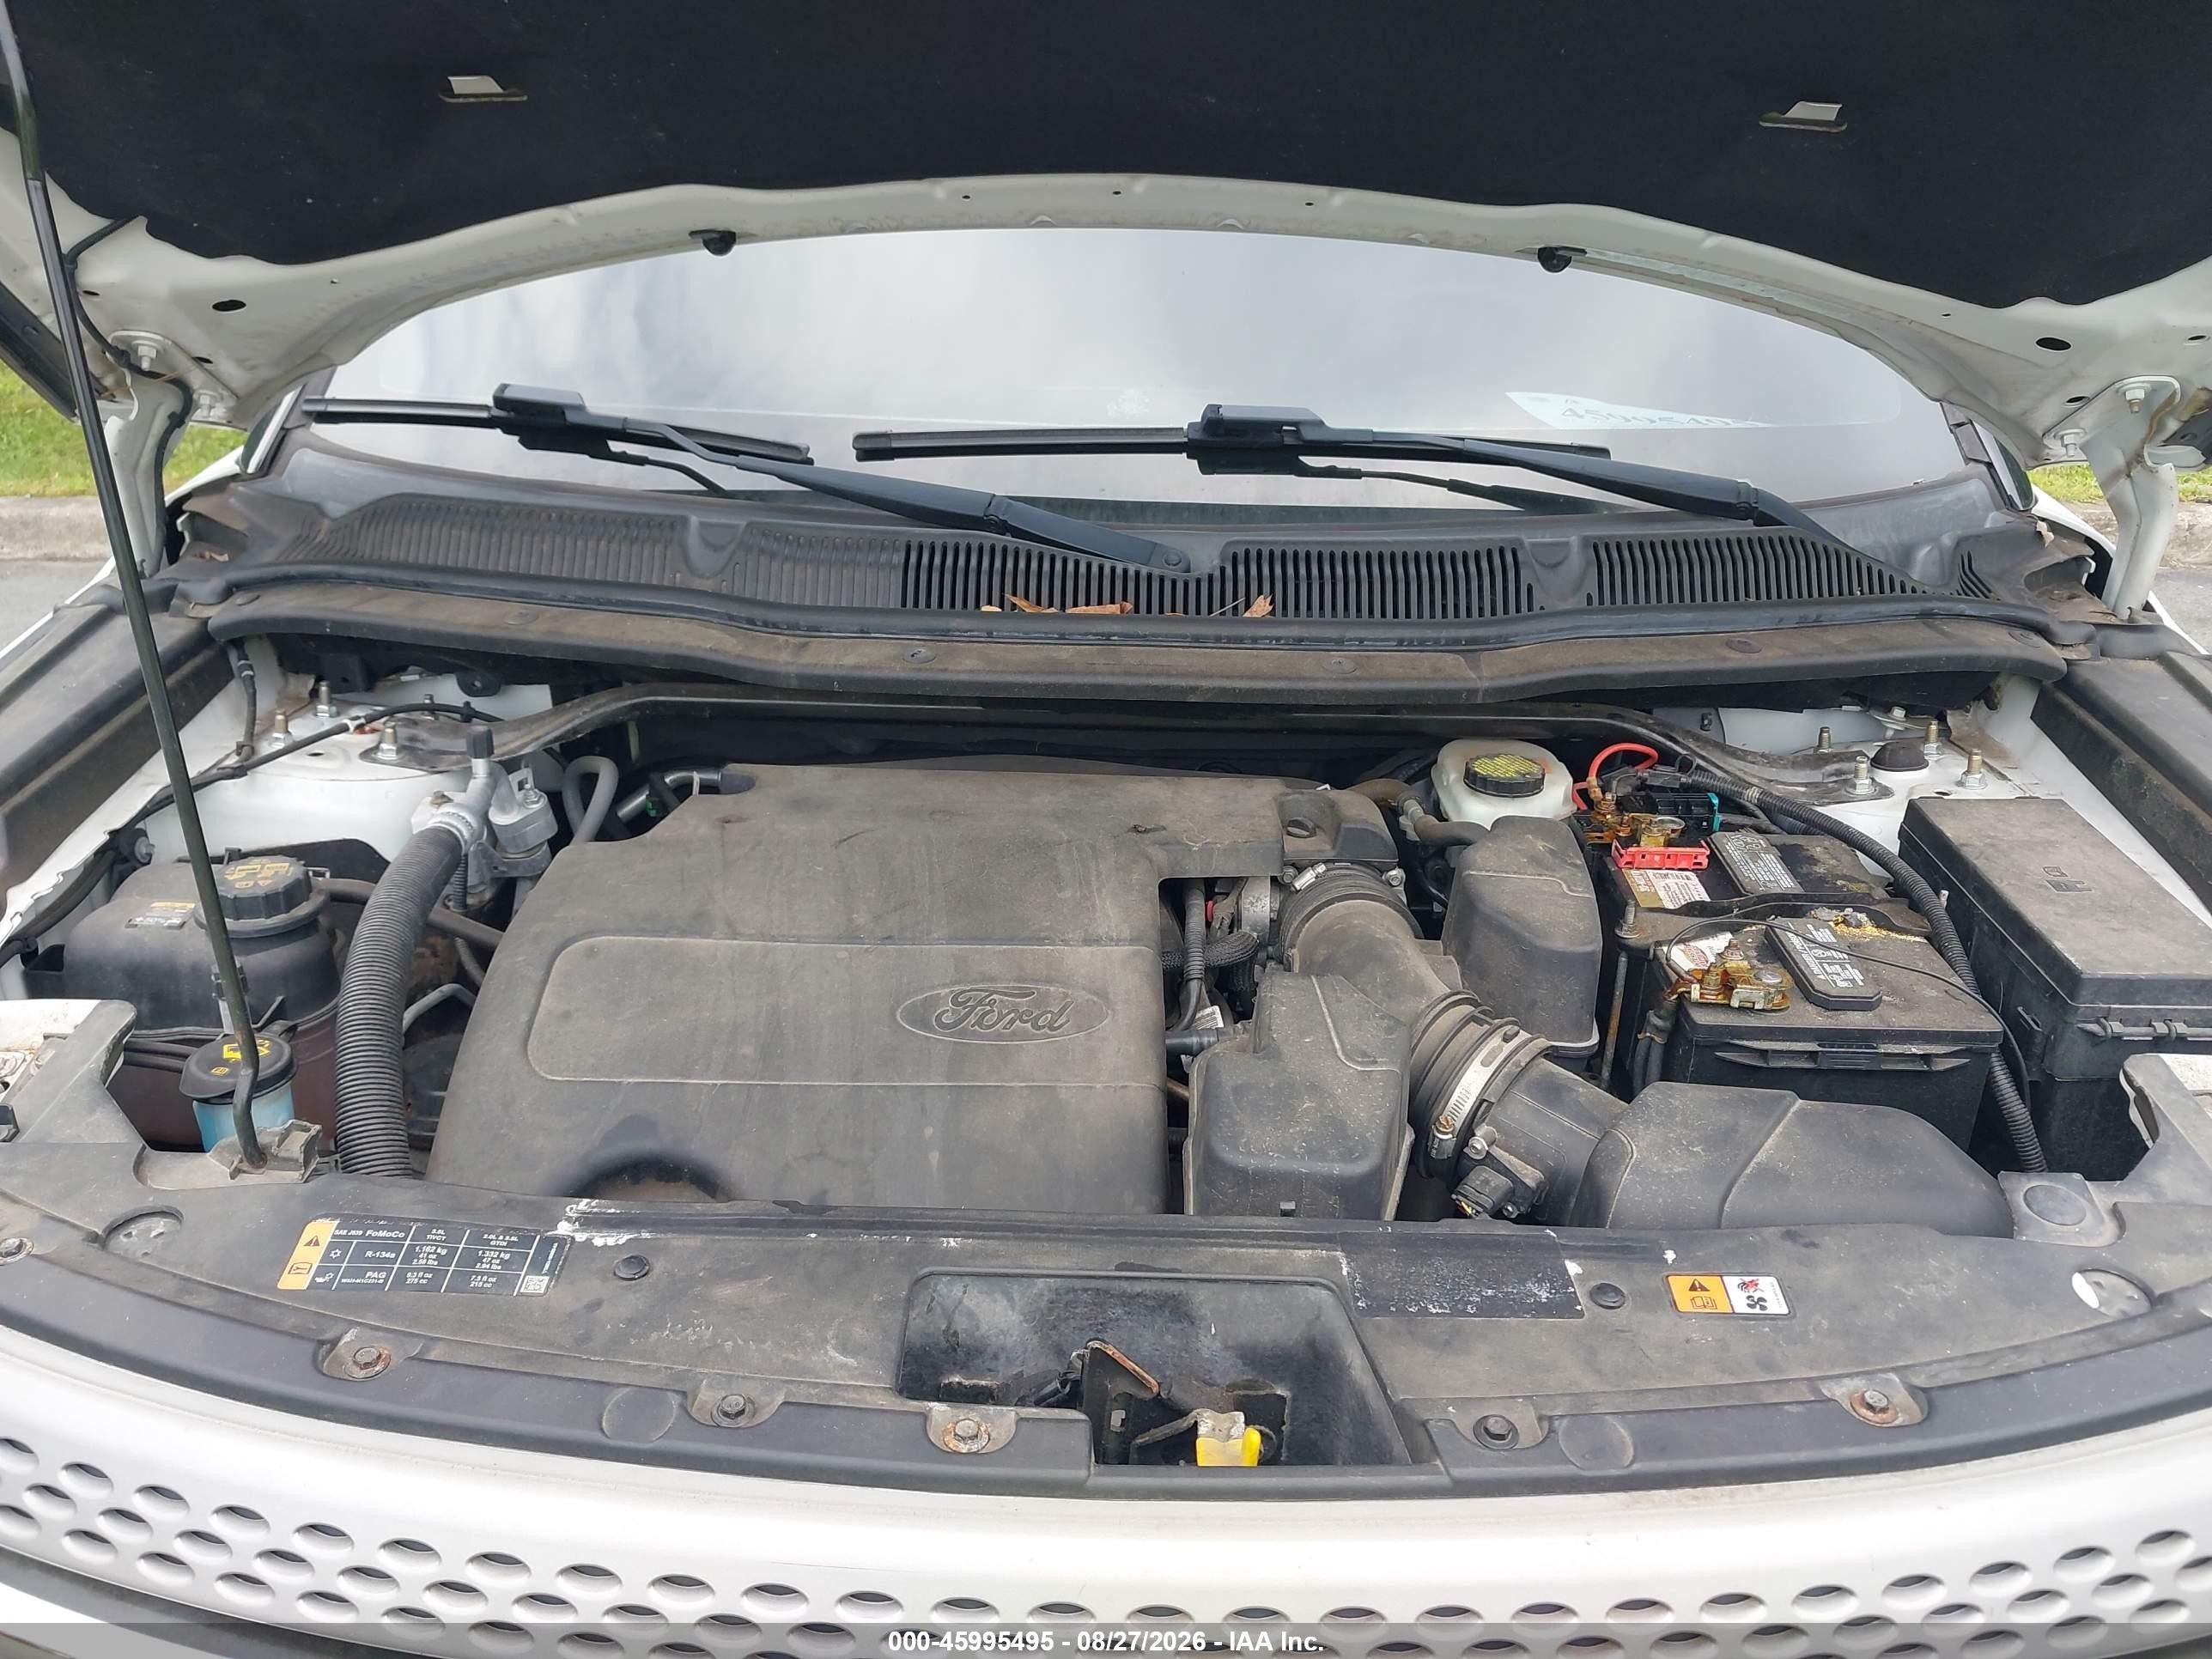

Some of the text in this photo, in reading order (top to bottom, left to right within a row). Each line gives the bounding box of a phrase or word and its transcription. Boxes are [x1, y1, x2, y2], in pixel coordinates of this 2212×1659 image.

[933, 988, 1074, 1032] Ford
[365, 1230, 405, 1238] FoMoCo
[436, 1247, 447, 1255] kg
